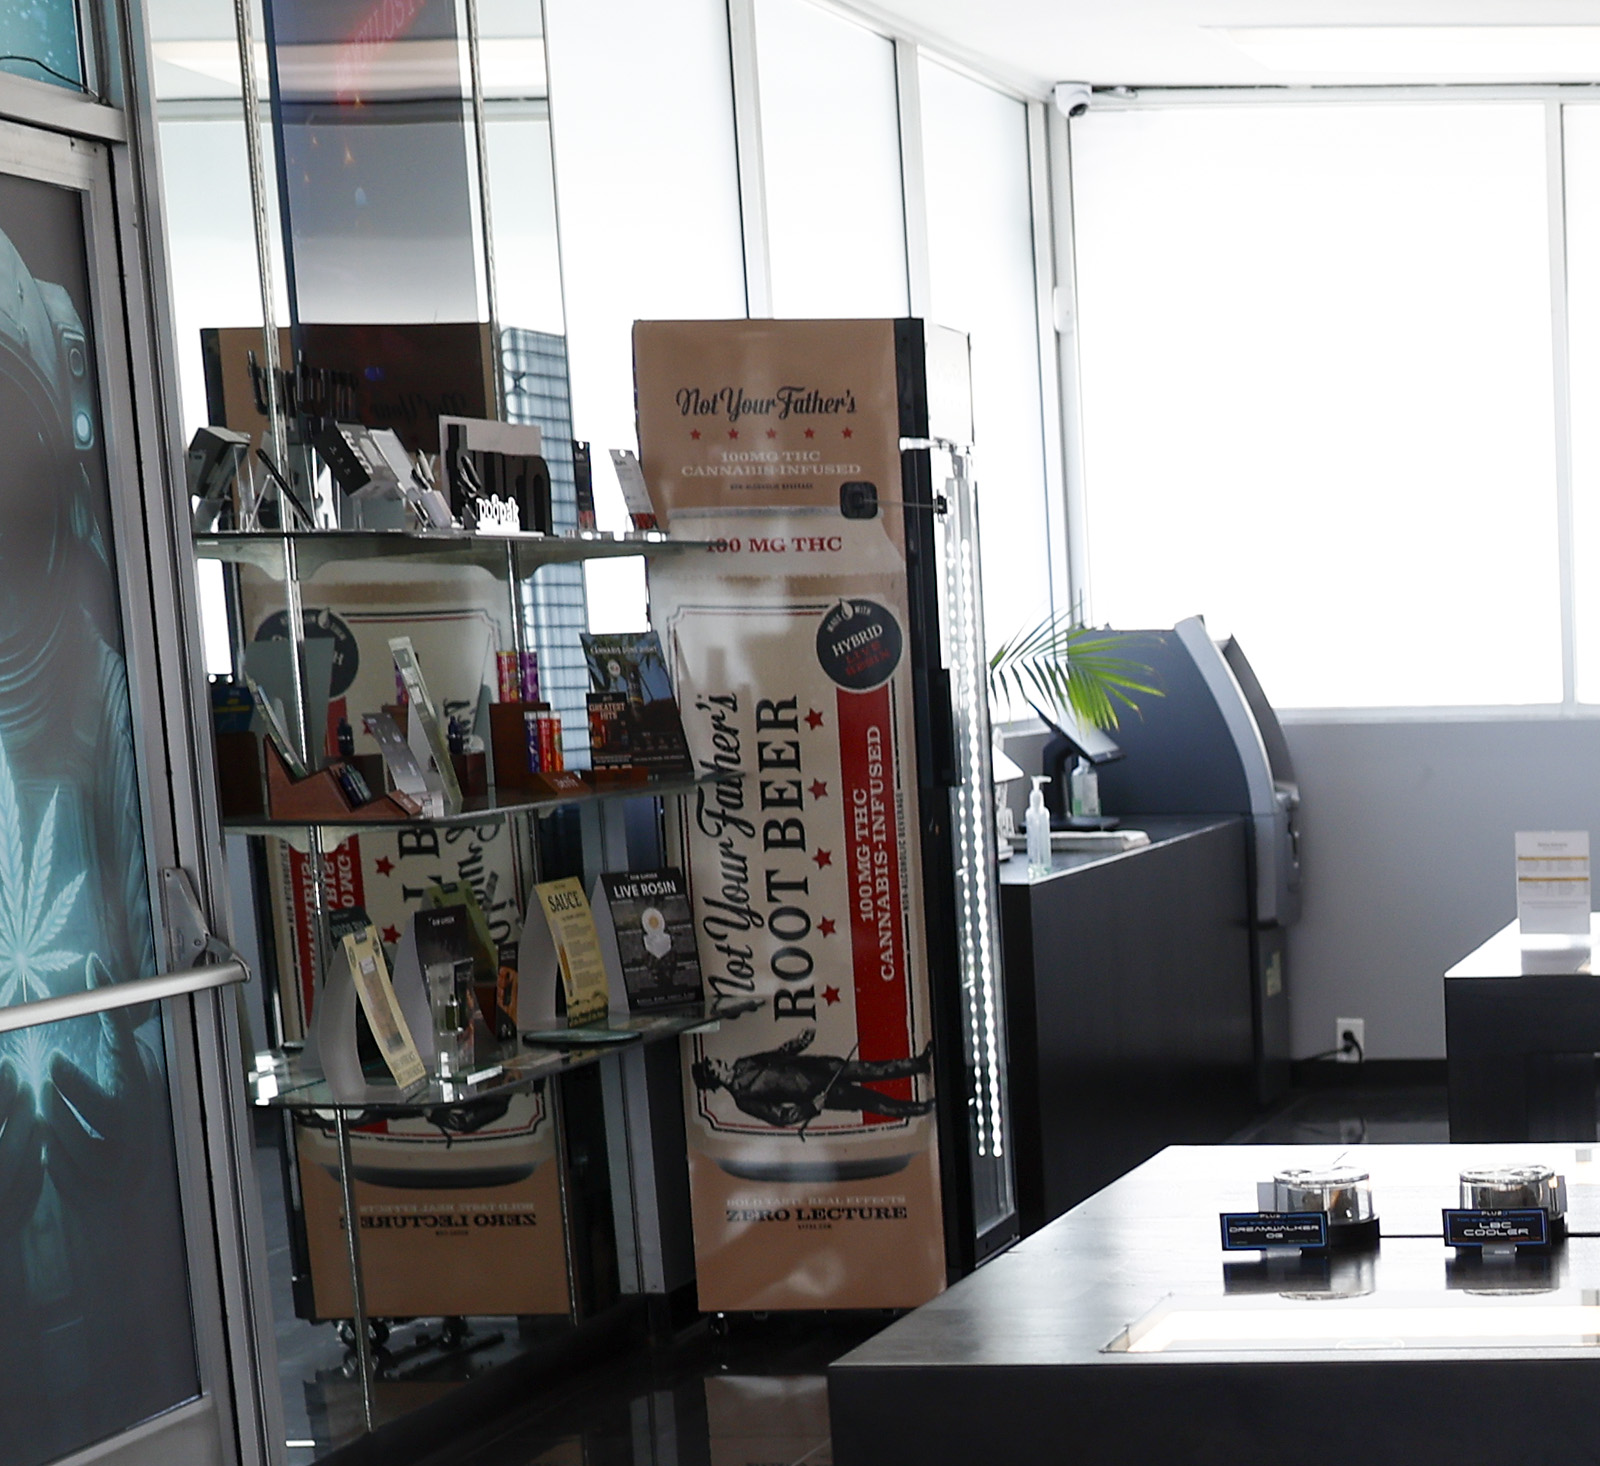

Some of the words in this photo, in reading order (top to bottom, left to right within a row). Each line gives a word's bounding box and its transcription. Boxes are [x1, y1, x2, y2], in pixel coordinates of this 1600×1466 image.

[676, 387, 720, 417] Not
[720, 387, 776, 423] Your
[777, 386, 857, 420] Father's
[681, 464, 861, 478] CANNABIS-INFUSED
[721, 450, 778, 463] 100MG
[783, 450, 820, 462] THC
[749, 538, 786, 553] MG
[788, 536, 842, 552] THC
[831, 624, 884, 657] HYBRID
[696, 692, 756, 838] Father's
[755, 695, 808, 853] BEER
[853, 788, 869, 837] THC
[867, 725, 896, 983] CANNABIS-INFUSED
[613, 884, 640, 899] LIVE
[641, 880, 677, 896] ROSIN
[703, 837, 764, 941] Your
[856, 844, 874, 922] 100MG
[547, 890, 583, 913] SAUCE
[765, 868, 817, 1022] ROOT
[707, 943, 756, 1016] Not
[726, 1208, 790, 1222] ZERO
[796, 1206, 908, 1222] LECTURE
[1229, 1224, 1319, 1233] DREAMWALKER
[1463, 1228, 1529, 1237] COOLER
